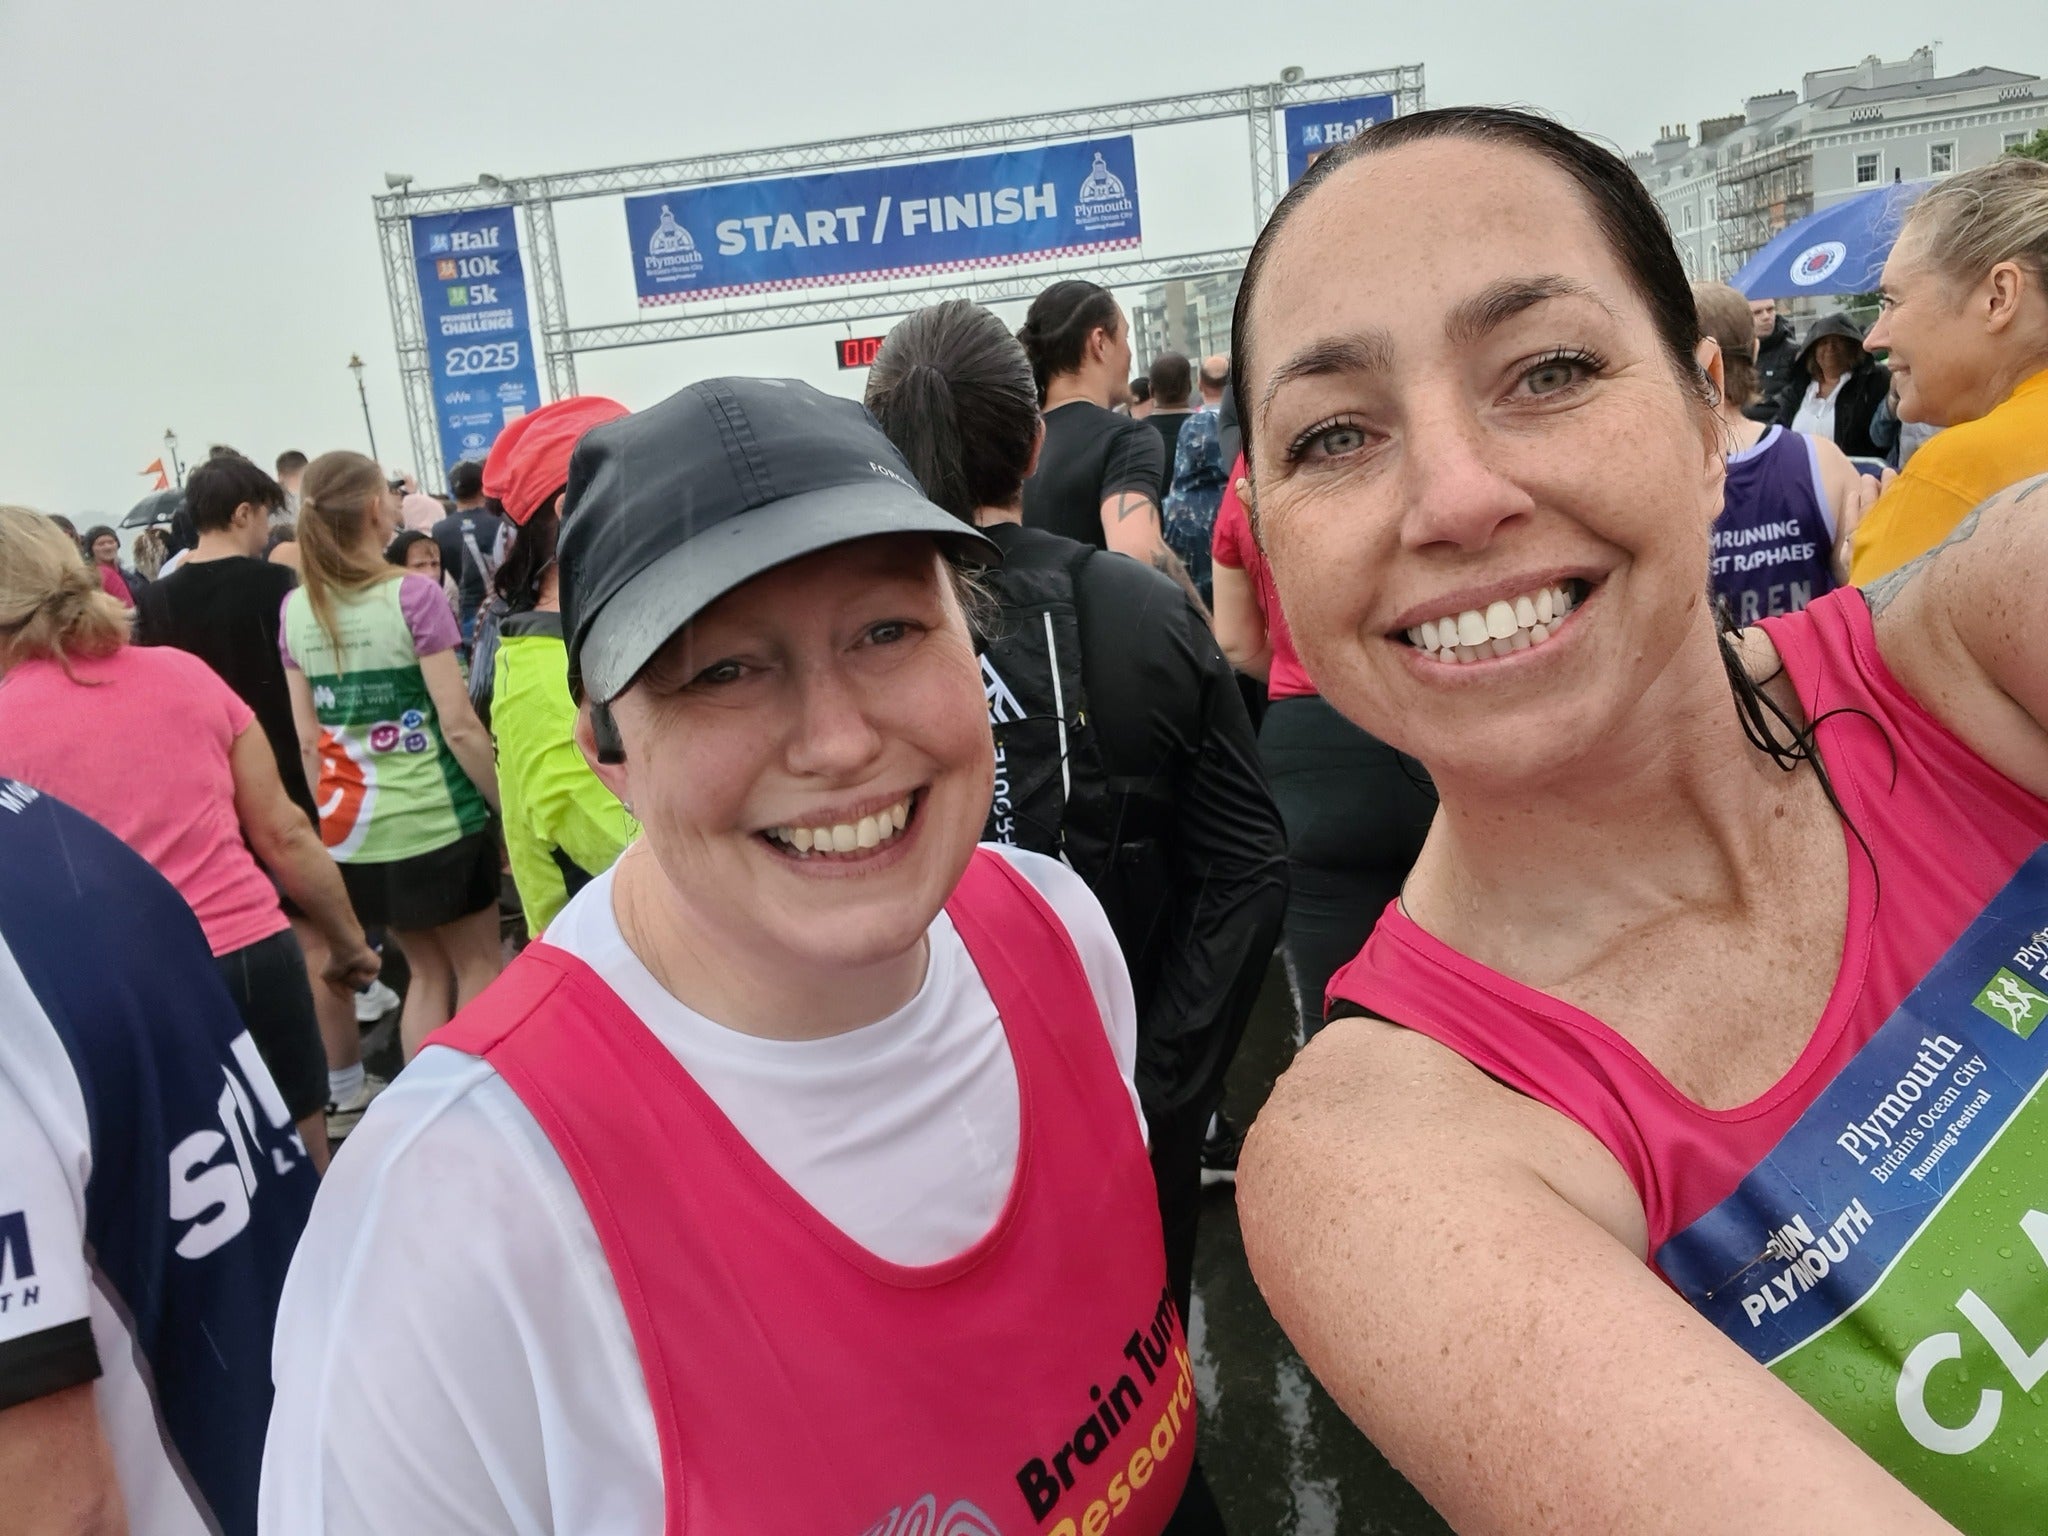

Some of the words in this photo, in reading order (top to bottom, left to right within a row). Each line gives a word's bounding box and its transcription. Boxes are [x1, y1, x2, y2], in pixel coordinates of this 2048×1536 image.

[715, 206, 866, 256] START
[872, 196, 892, 244] /
[900, 182, 1058, 236] FINISH
[1074, 198, 1132, 217] Plymouth
[451, 227, 499, 252] Half
[458, 258, 500, 279] 10k
[645, 250, 703, 270] Plymouth
[470, 286, 498, 306] 5k
[441, 316, 514, 336] CHALLENGE
[445, 341, 519, 376] 2025
[844, 339, 877, 366] 00
[1836, 1034, 1963, 1166] Plymouth
[1870, 1127, 1925, 1184] Britain's
[1917, 1086, 1961, 1129] Ocean
[1952, 1054, 1988, 1087] City
[1909, 1132, 1958, 1182] Running
[1947, 1088, 1992, 1137] Festival
[1741, 1197, 1874, 1328] PLYMOUTH
[0, 1284, 39, 1313] TH
[1016, 1375, 1143, 1524] Brain
[1123, 1286, 1177, 1386] Tum
